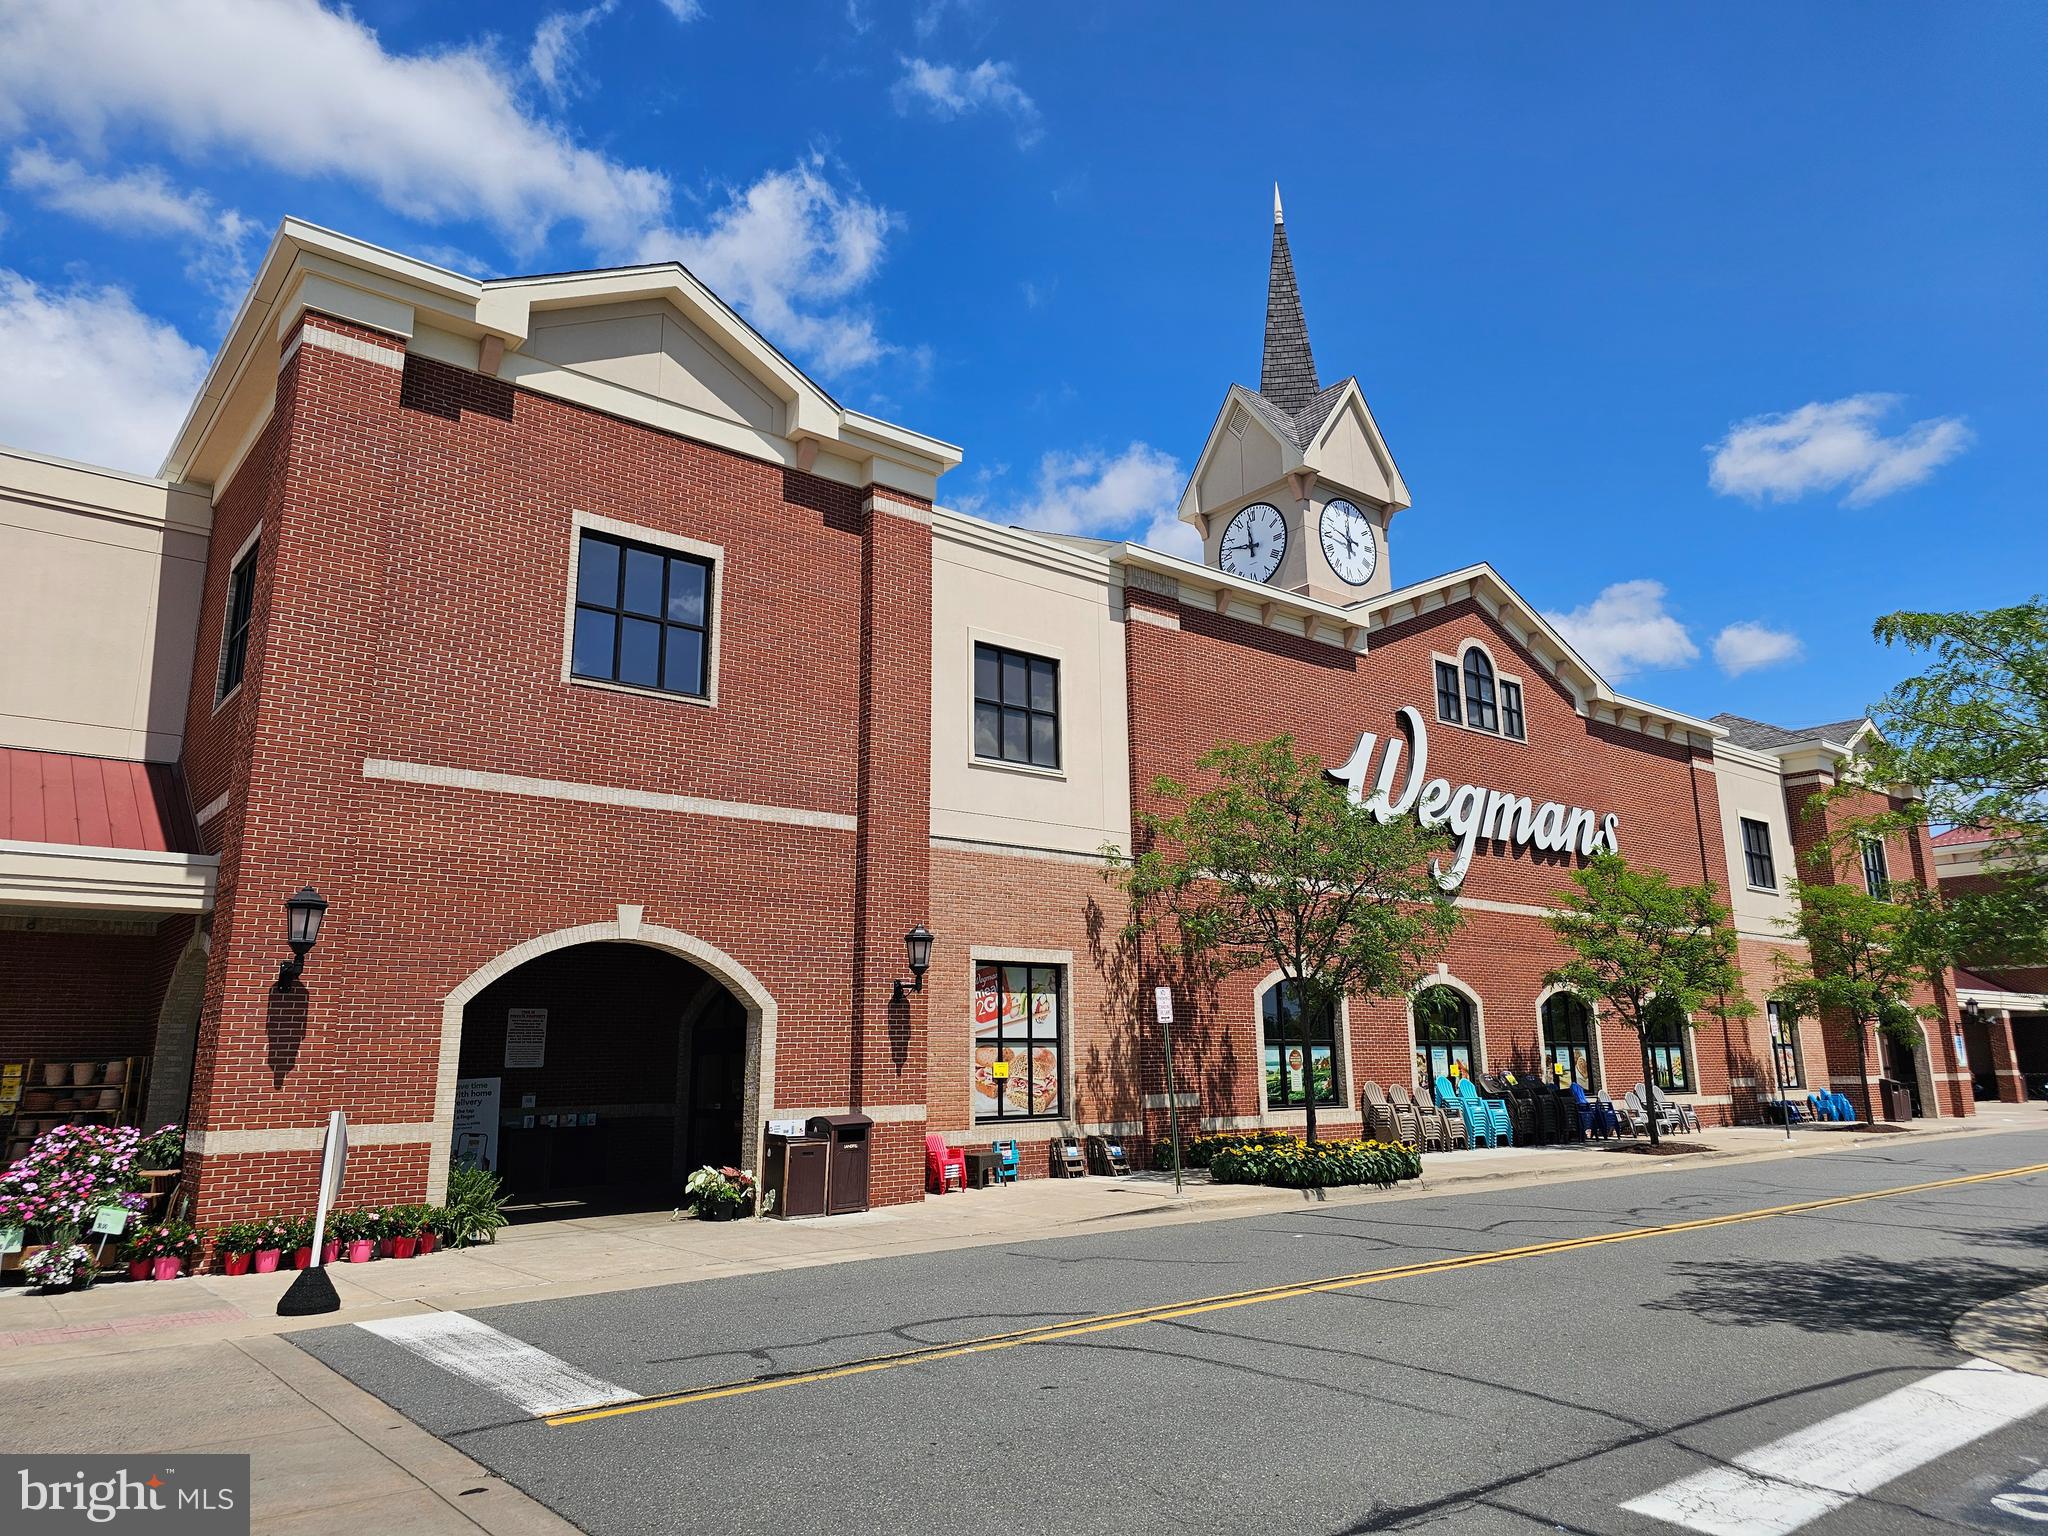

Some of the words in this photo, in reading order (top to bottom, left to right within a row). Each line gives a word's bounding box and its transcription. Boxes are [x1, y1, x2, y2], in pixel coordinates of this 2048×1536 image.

[1327, 706, 1619, 890] Wegmans
[456, 1090, 469, 1098] ith
[456, 1098, 483, 1107] elivery
